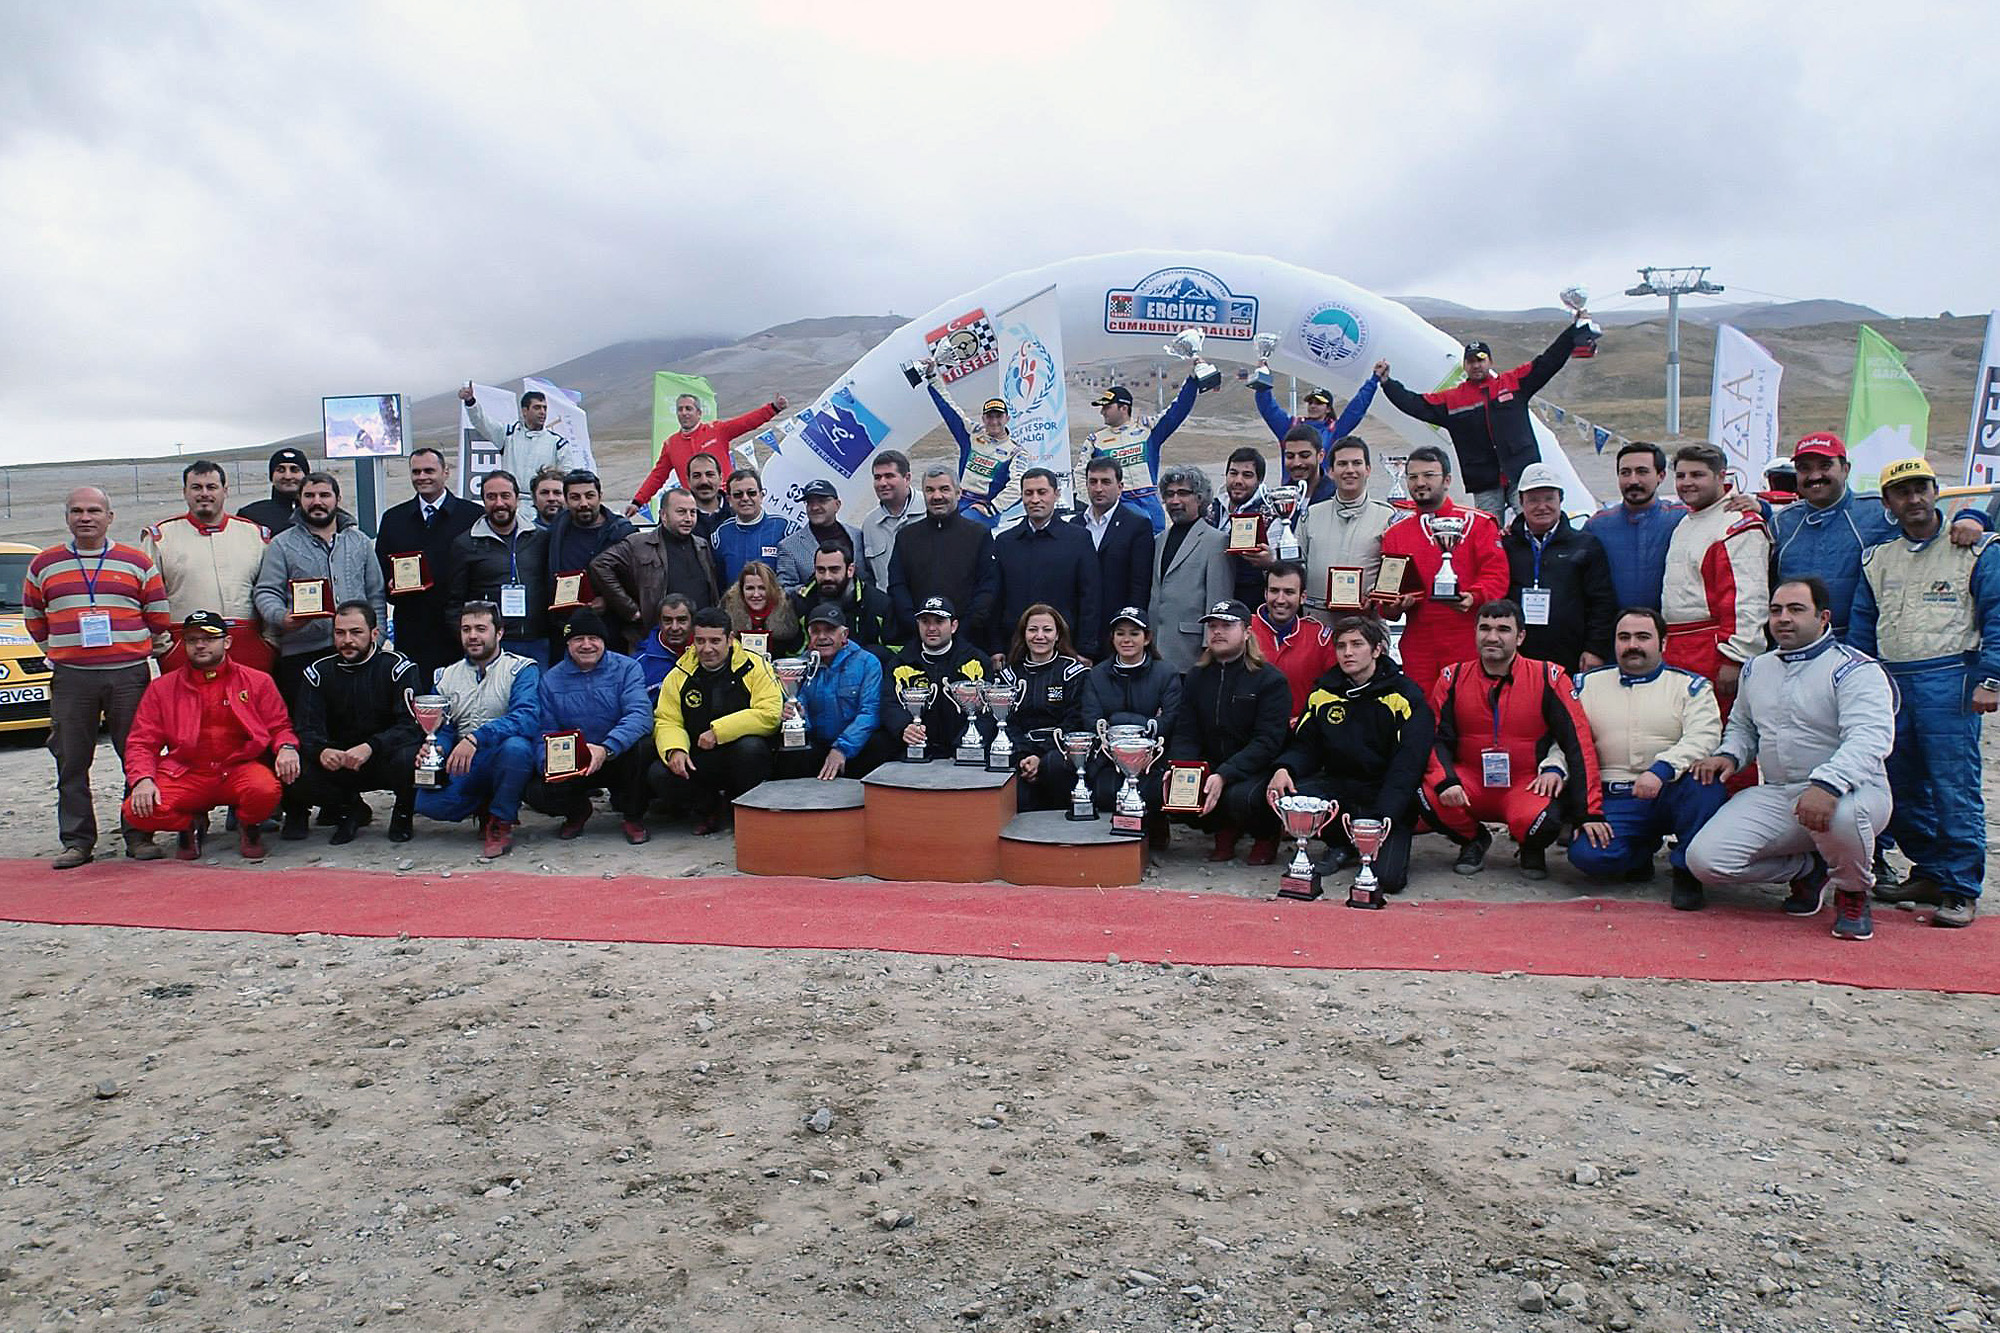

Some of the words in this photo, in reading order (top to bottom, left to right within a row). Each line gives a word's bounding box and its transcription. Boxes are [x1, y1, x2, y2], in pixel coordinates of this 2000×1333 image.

[1145, 300, 1217, 323] ERCİYES
[943, 349, 999, 383] TOSFED
[1755, 368, 1766, 417] TERMAL
[1033, 421, 1058, 432] SPOR
[0, 687, 44, 703] avea
